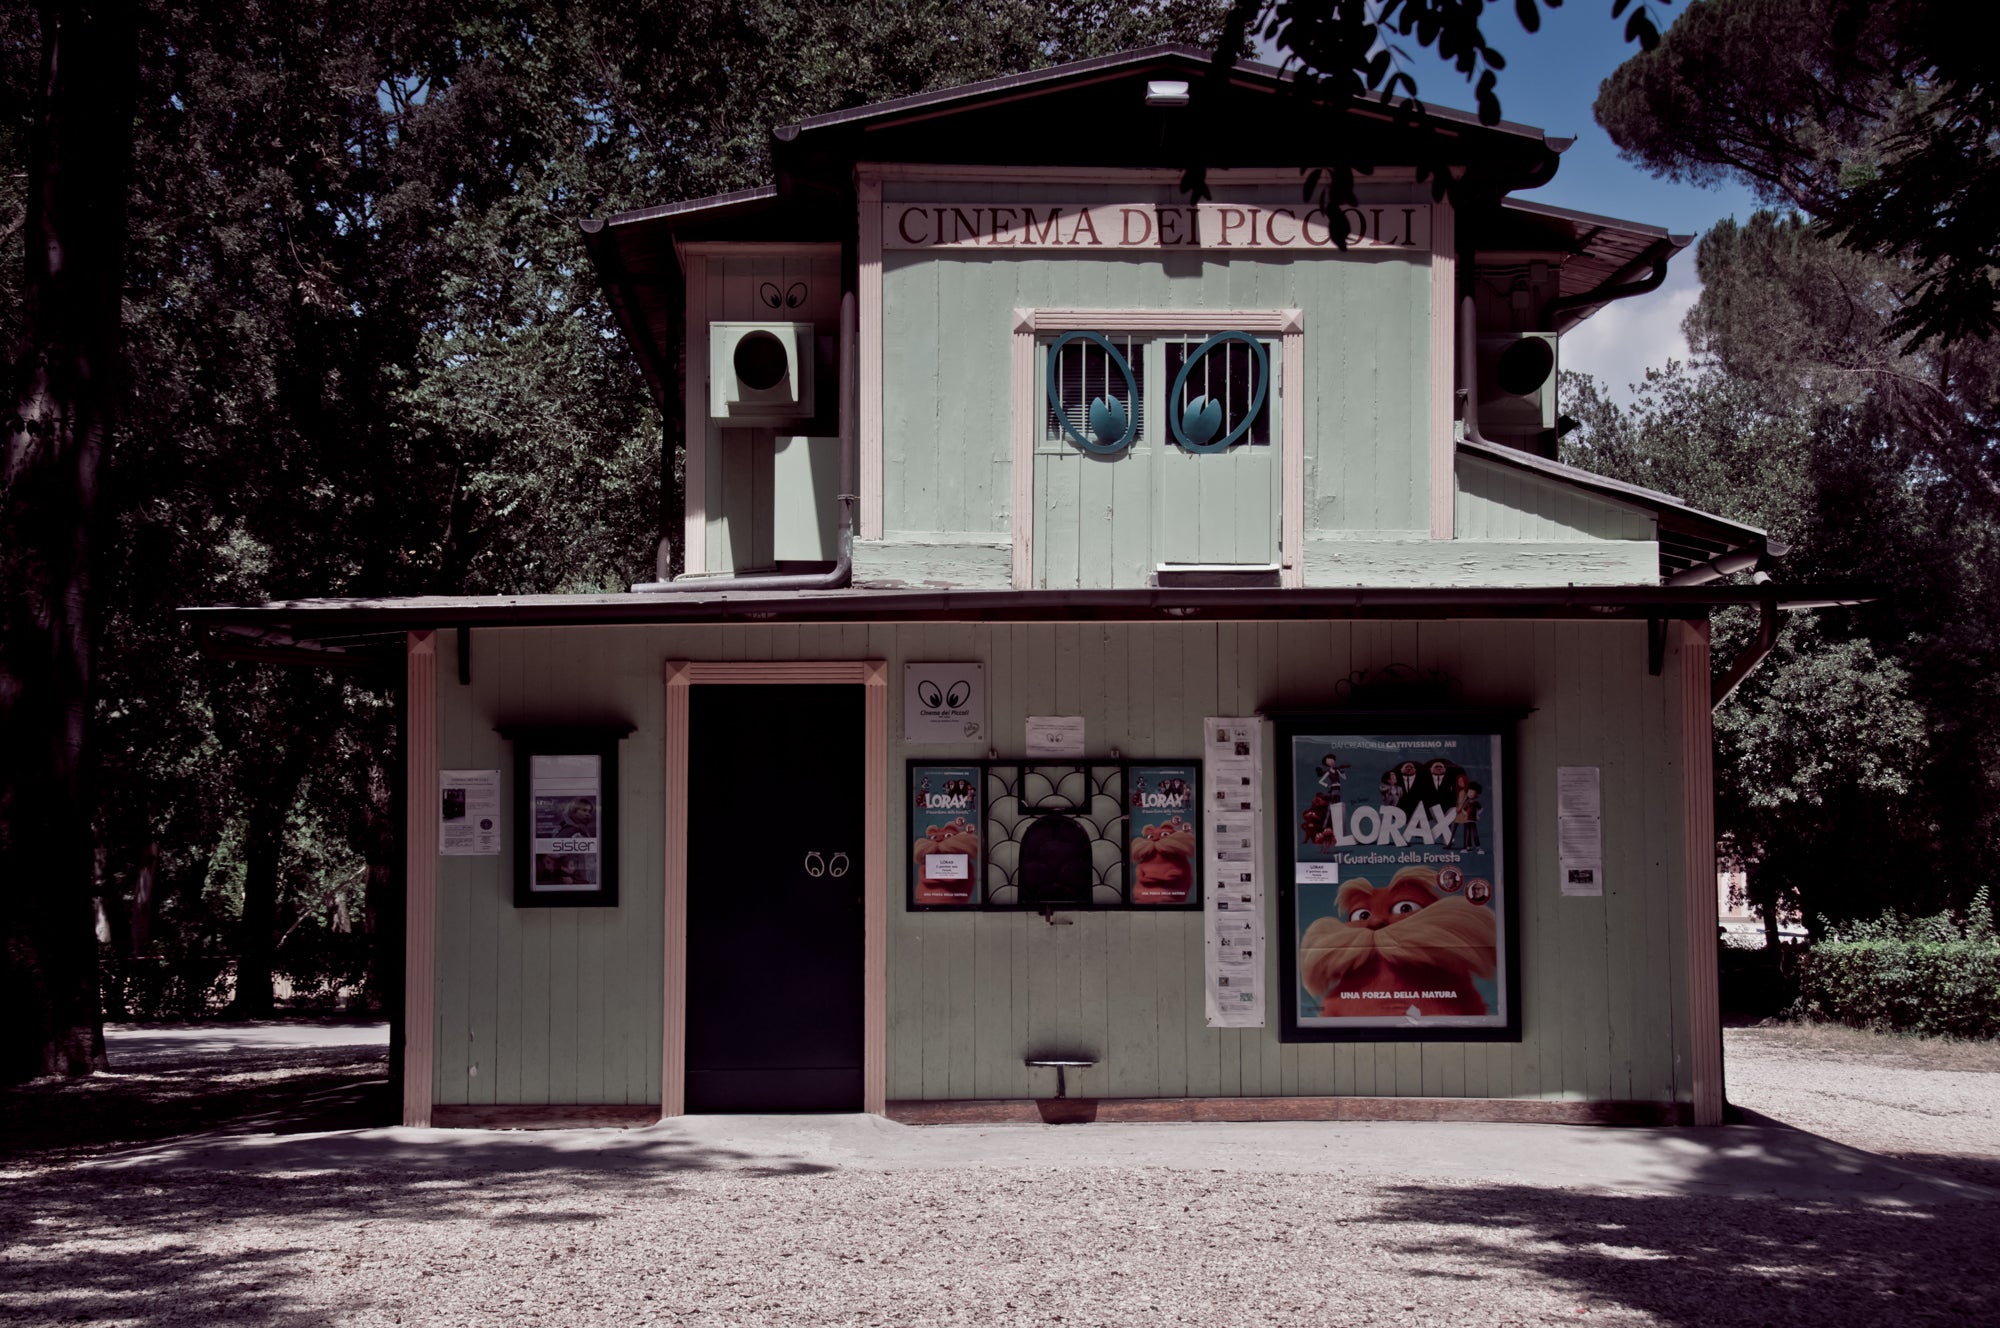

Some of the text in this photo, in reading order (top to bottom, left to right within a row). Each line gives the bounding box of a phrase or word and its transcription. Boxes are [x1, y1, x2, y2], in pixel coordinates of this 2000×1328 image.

[899, 207, 1416, 246] CINEMA DEI PICCOLI
[1385, 740, 1442, 749] CATTIVISSIMO
[1444, 740, 1457, 748] ME
[925, 793, 968, 808] LORAX
[1140, 792, 1184, 808] LORAX
[1329, 800, 1457, 847] LORAX
[552, 839, 595, 852] sister
[1333, 851, 1461, 864] Il Guardiano della Foresta
[1340, 990, 1458, 1000] UNA FORZA DELLA NATURA
